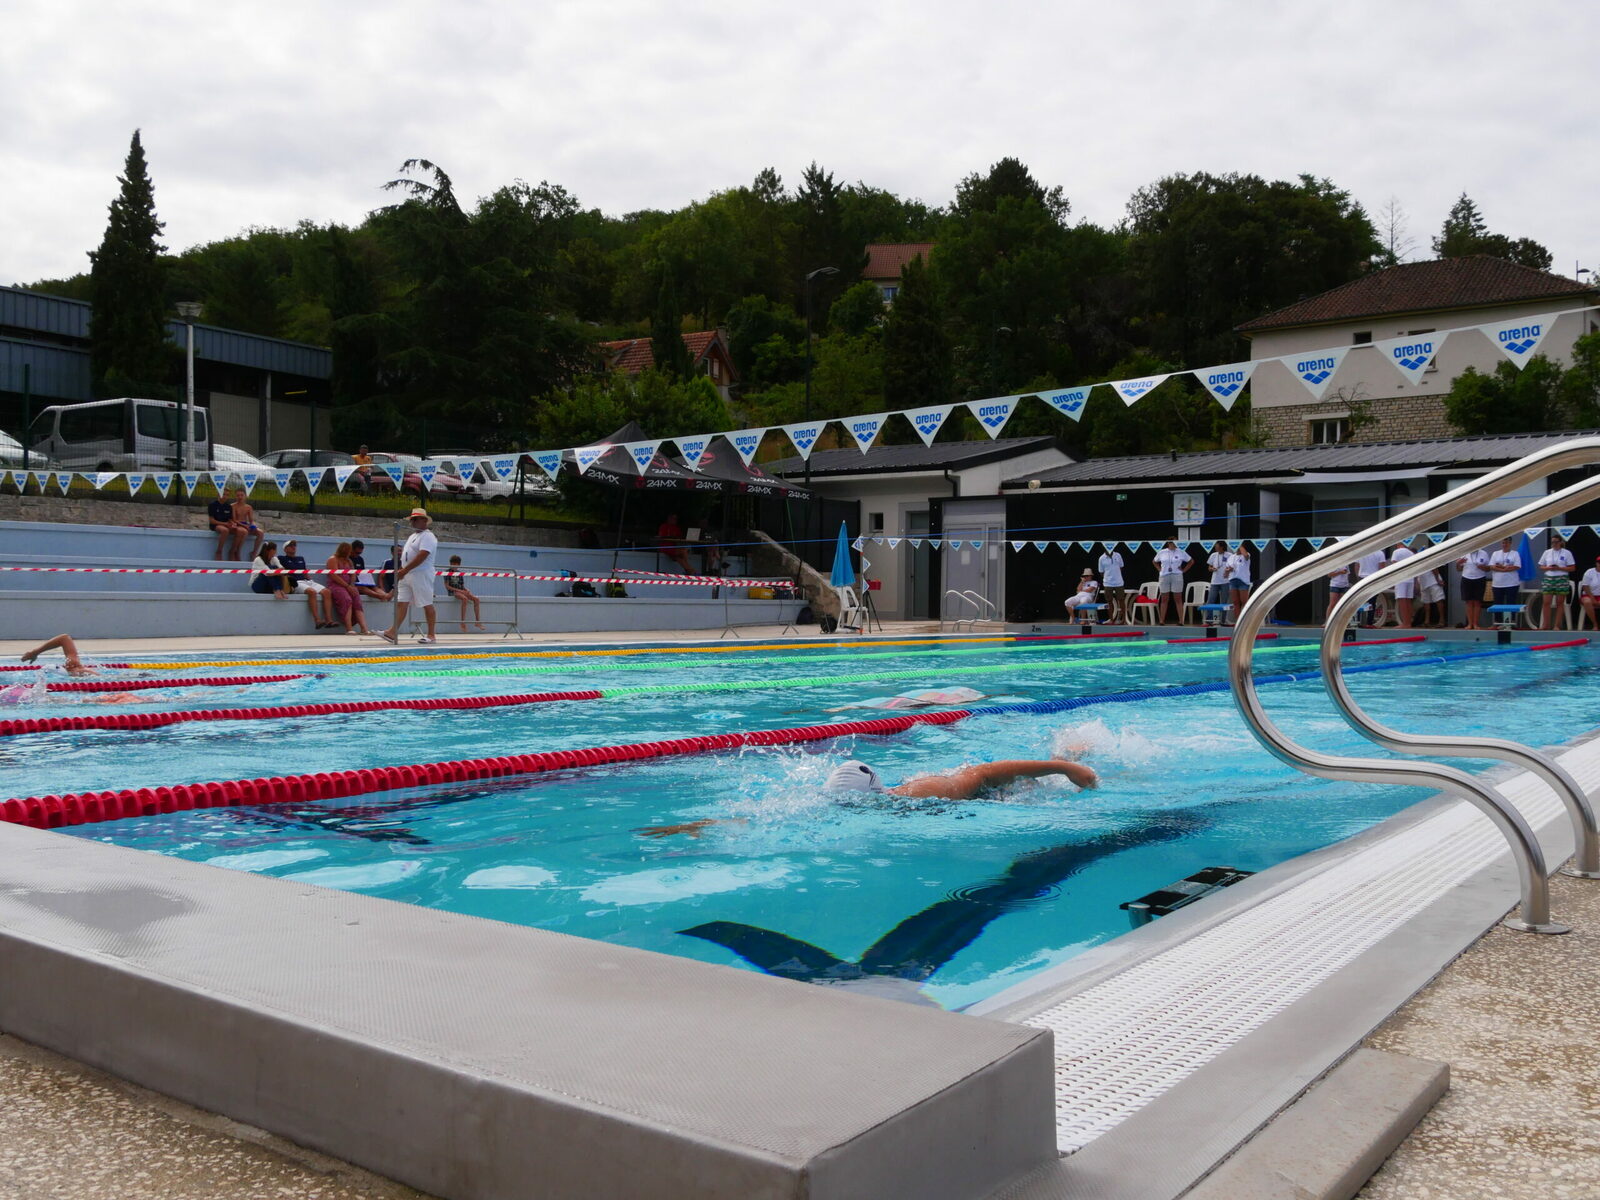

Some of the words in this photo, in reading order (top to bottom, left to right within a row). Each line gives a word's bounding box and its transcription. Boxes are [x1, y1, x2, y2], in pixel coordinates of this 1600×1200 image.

[1499, 324, 1541, 343] arena
[1394, 341, 1432, 359] arena
[1297, 356, 1335, 373] arena
[1208, 370, 1244, 385] arena
[1120, 379, 1154, 389] arena
[1052, 391, 1084, 405] arena
[979, 403, 1008, 418] arena
[915, 412, 942, 426] arena
[853, 420, 877, 433] arena
[793, 427, 816, 440] arena
[682, 441, 704, 452] arena
[736, 435, 758, 446] arena
[634, 446, 653, 456] arena
[495, 459, 514, 468] arena
[538, 454, 559, 463] arena
[587, 468, 620, 486] 24MX
[646, 479, 678, 488] 24MX
[695, 480, 723, 491] 24MX
[747, 485, 772, 495] 24MX
[787, 490, 811, 500] 24MX
